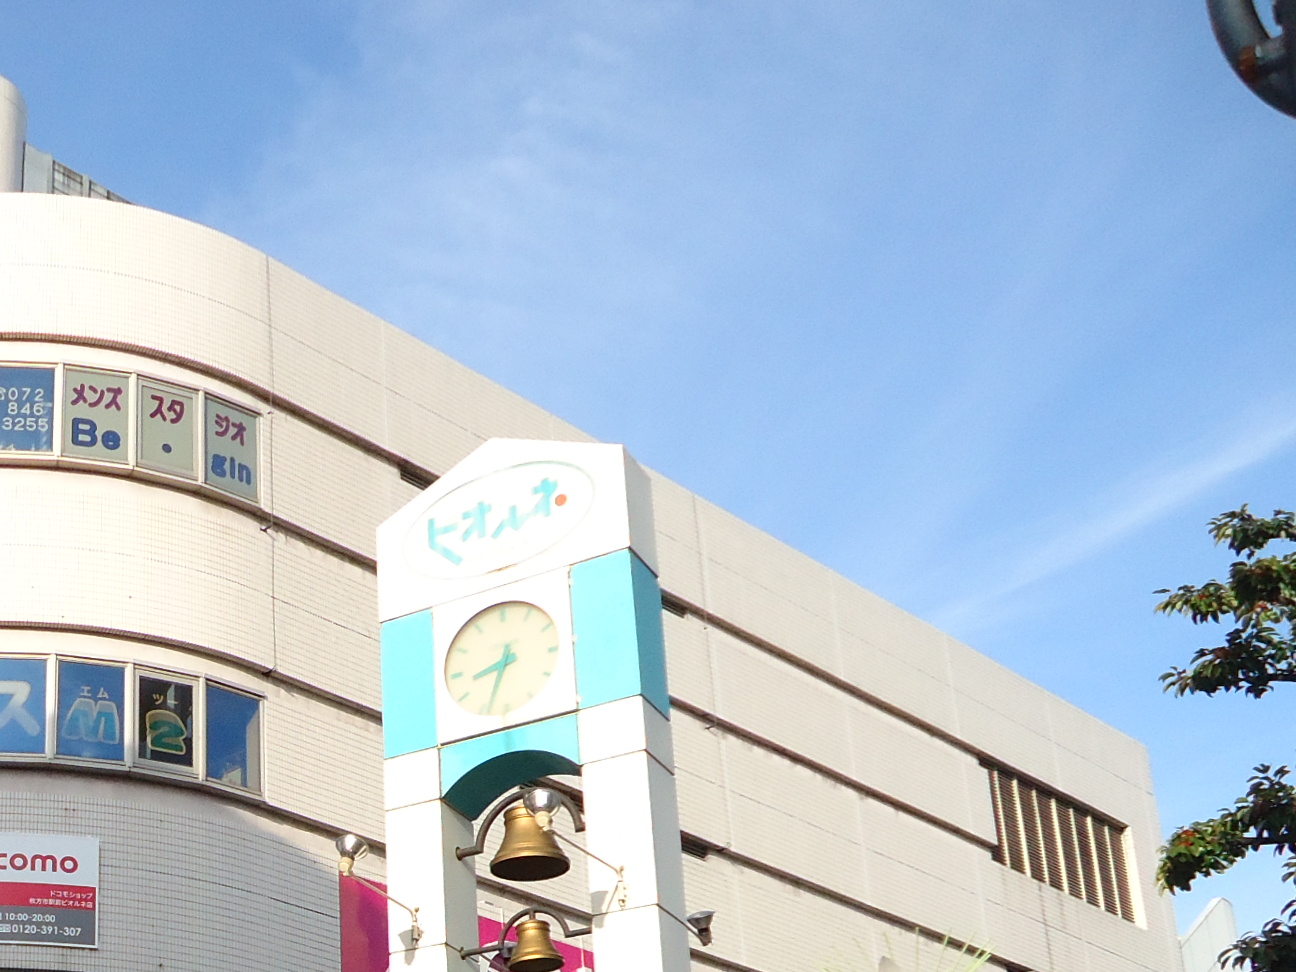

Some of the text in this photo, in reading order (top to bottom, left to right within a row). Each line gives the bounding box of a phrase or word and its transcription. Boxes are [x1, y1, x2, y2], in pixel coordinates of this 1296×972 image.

[8, 387, 45, 401] 072
[7, 401, 44, 415] 846
[2, 417, 49, 431] 3255
[50, 890, 94, 899] ドコモショップ
[5, 912, 56, 923] 10:00-20:00
[11, 923, 82, 937] 0120-391-307
